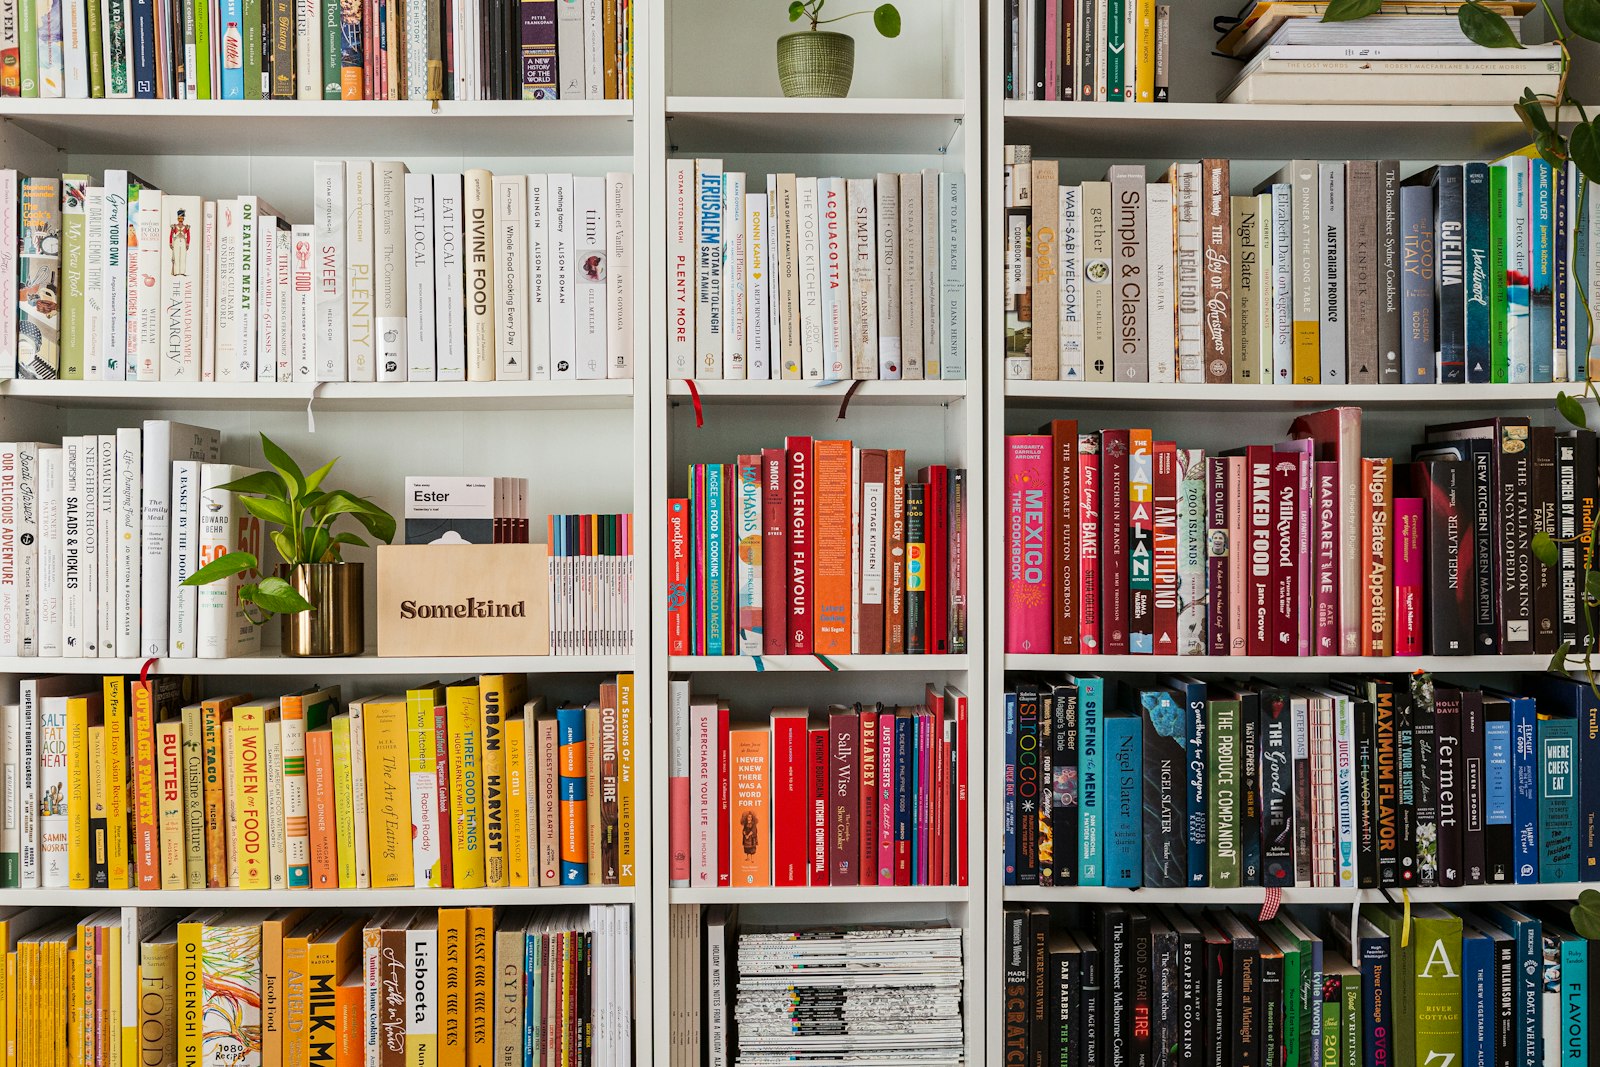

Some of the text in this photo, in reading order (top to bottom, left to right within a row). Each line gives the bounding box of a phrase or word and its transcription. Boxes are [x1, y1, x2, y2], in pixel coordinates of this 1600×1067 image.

[328, 3, 338, 28] Food
[701, 173, 720, 244] JERUSALEM
[1386, 170, 1395, 188] The
[1540, 164, 1548, 220] JAMIE OLIVER
[473, 208, 485, 262] DIVINE
[586, 210, 596, 244] time
[827, 191, 839, 289] ACQUACOTTA
[857, 207, 868, 260] SIMPLE
[1090, 208, 1103, 253] gather
[1212, 225, 1223, 246] THE
[1385, 188, 1395, 237] Broadsheet
[109, 224, 119, 266] YOUR OWN
[242, 204, 252, 309] ON EATING MEAT
[321, 246, 337, 295] SWEET
[507, 252, 515, 269] Food
[701, 246, 710, 303] SAMI TAMIMI
[885, 229, 894, 265] OSTRO
[1121, 191, 1140, 354] Simple & Classic
[1441, 221, 1462, 286] GJELINA
[352, 264, 369, 347] PLENTY
[474, 269, 487, 315] FOOD
[506, 270, 514, 303] Cooking
[677, 255, 686, 342] PLENTY MORE
[711, 246, 720, 334] YOTAM OTTOLENGHI
[1066, 258, 1076, 322] WELCOME
[1387, 267, 1396, 313] Cookbook
[507, 328, 516, 346] Day
[86, 447, 94, 554] NEIGHBOURHOOD
[103, 442, 111, 512] COMMUNITY
[414, 491, 450, 502] Ester
[770, 461, 779, 490] SMOKE
[1, 453, 14, 585] OUR DELICIOUS ADVENTURE
[67, 497, 78, 535] SALADS
[793, 452, 804, 615] OTTOLENGHI FLAVOUR
[1012, 491, 1021, 580] THE COOKBOOK
[1025, 490, 1043, 583] MEXICO
[1154, 507, 1176, 527] AM
[1155, 533, 1175, 541] A
[1253, 463, 1270, 576] NAKED FOOD
[1321, 476, 1333, 559] MARGARET
[1505, 484, 1515, 591] ENCYCLOPEDIA
[1517, 458, 1528, 616] THE ITALIAN COOKING
[67, 549, 78, 589] PICKLES
[1155, 547, 1176, 610] FILIPINO
[1369, 466, 1387, 634] Nigel Slater Appetite
[1448, 515, 1458, 590] NIGEL SLATER
[400, 598, 525, 619] Somekind
[1256, 583, 1266, 641] Jane Grover
[41, 714, 67, 726] SALT
[42, 740, 66, 754] ACID
[44, 727, 63, 740] FAT
[700, 717, 708, 778] SUPERCHARGE
[40, 754, 67, 767] HEAT
[163, 734, 178, 801] BUTTER
[485, 691, 502, 852] URBAN HARVEST
[602, 708, 616, 802] COOKING FIRE
[832, 732, 851, 796] Sally Wise
[864, 721, 874, 788] DELANCEY
[1085, 701, 1096, 807] SURFING MENU
[1377, 693, 1395, 851] MAXIMUM FLAVOR
[1439, 736, 1457, 827] ferment
[1547, 745, 1569, 758] WHERE
[1548, 761, 1569, 774] CHEFS
[242, 736, 259, 854] WOMEN FOOD
[700, 781, 708, 805] YOUR
[1161, 760, 1171, 833] NIGEL SLATER
[1218, 710, 1233, 857] THE PRODUCE COMPANION
[1553, 776, 1564, 790] EAT
[816, 834, 824, 872] CONFIDENTIAL
[415, 942, 428, 1023] Lisboeta
[1418, 939, 1458, 978] A
[185, 943, 196, 1037] OTTOLENGHI
[266, 973, 276, 1032] Jacob Food
[504, 964, 517, 1027] GYPSY
[1184, 944, 1192, 1058] ESCAPISM COOKING
[1569, 983, 1581, 1058] FLAVOUR
[1135, 1007, 1148, 1036] FIRE
